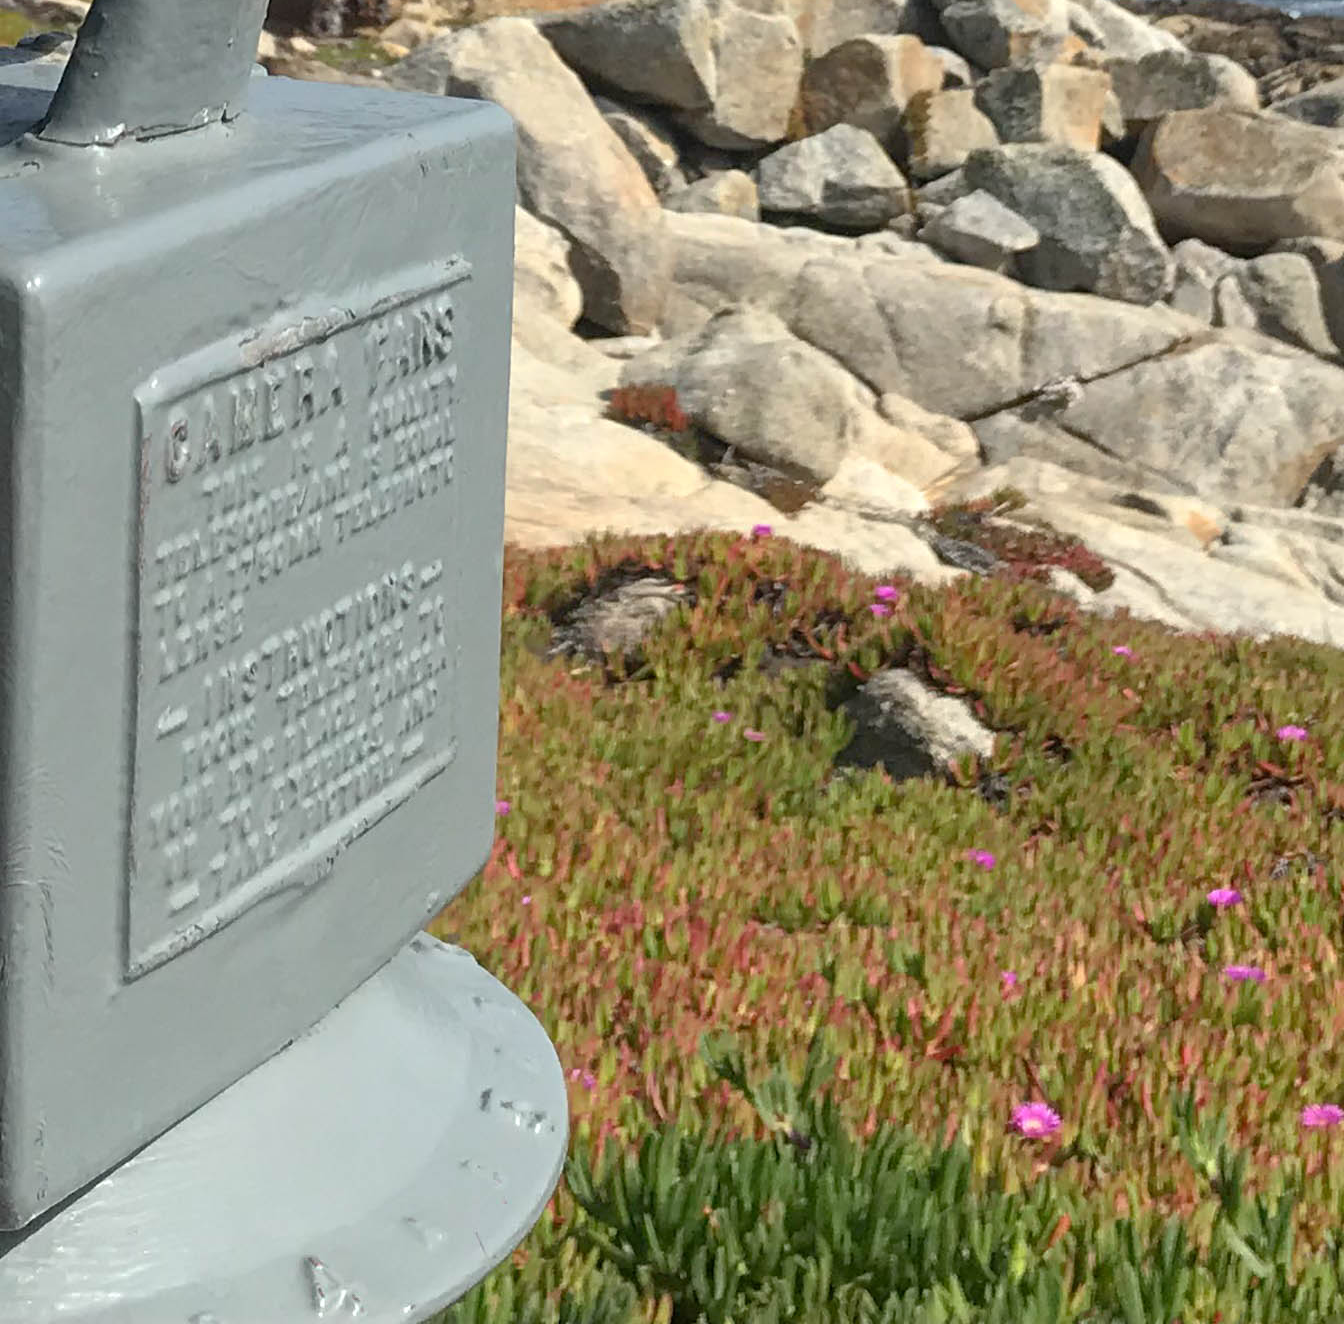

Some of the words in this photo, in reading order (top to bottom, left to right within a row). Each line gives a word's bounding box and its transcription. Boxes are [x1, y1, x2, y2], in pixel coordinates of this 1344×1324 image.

[165, 338, 343, 485] CAMERA
[364, 288, 456, 394] FANS
[201, 449, 265, 524] THIS
[290, 428, 313, 480] IS
[202, 556, 415, 727] INSTRUCTIONS
